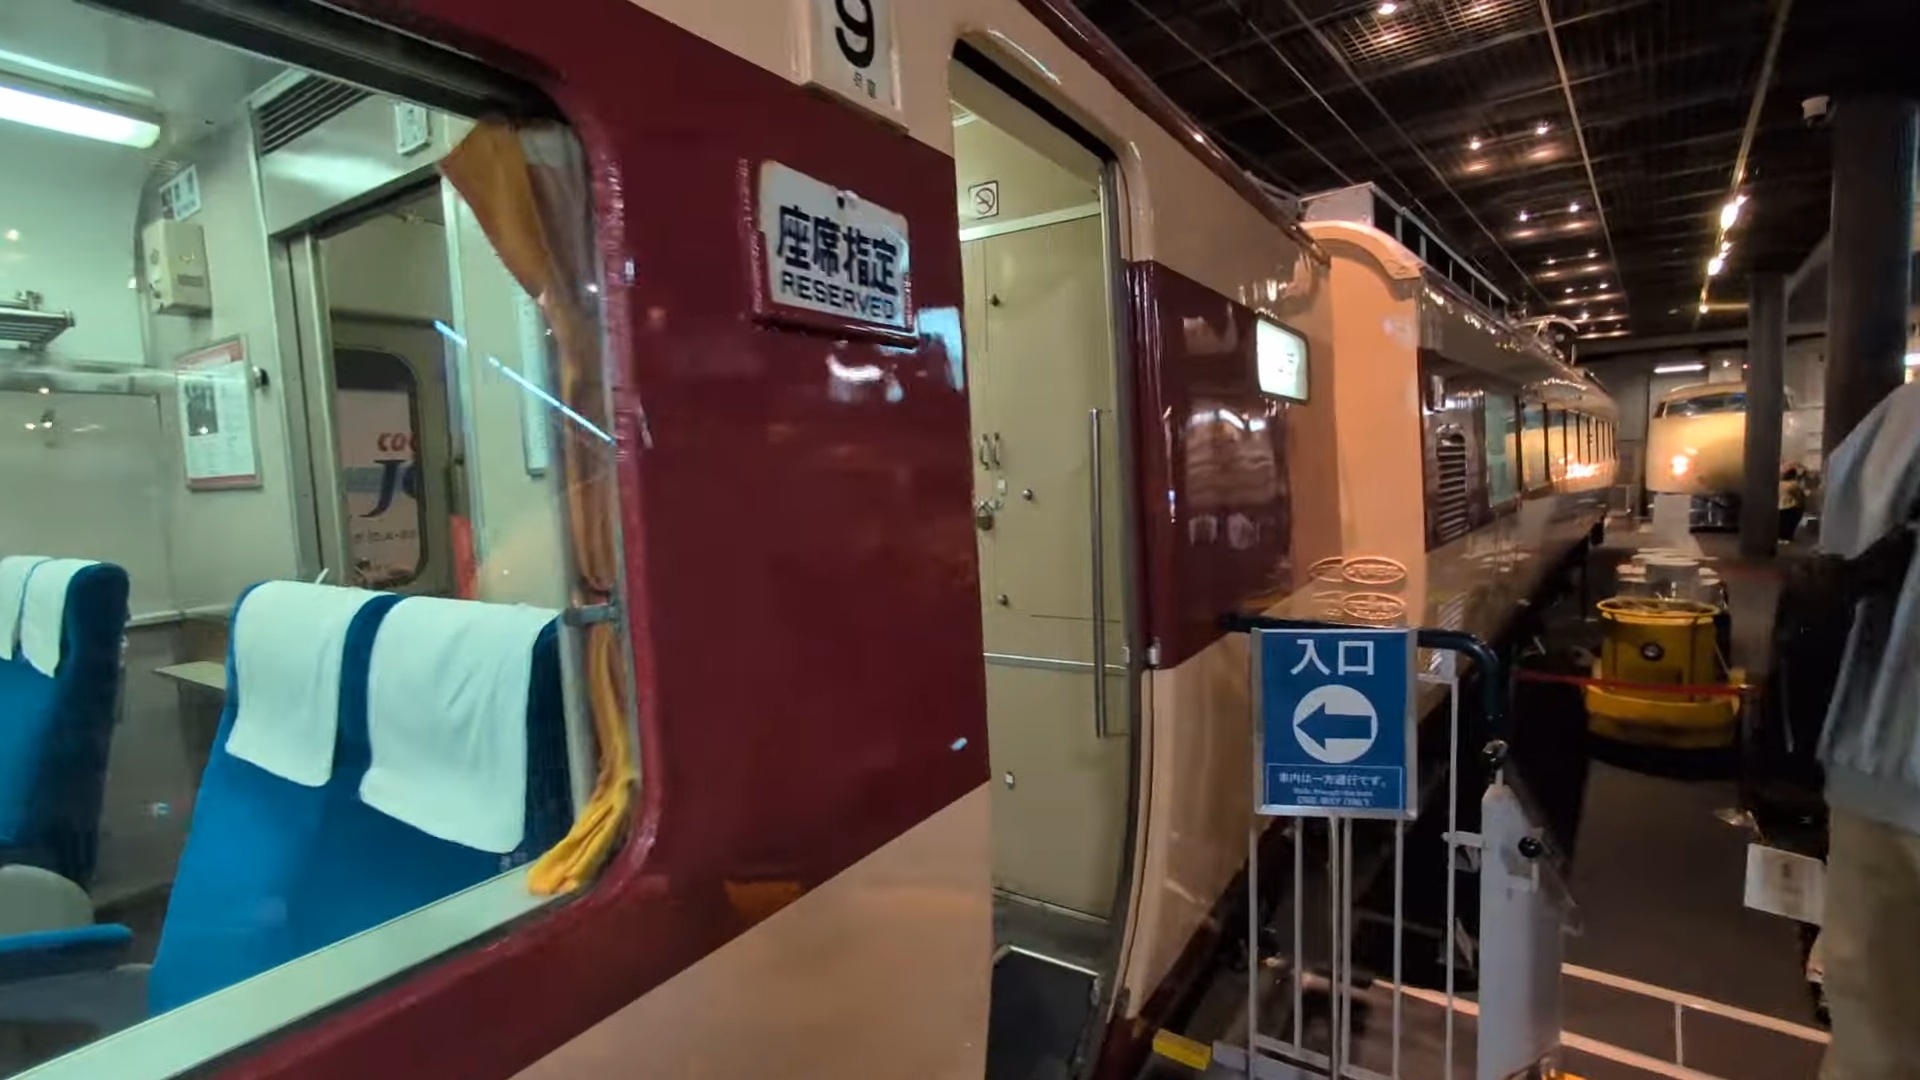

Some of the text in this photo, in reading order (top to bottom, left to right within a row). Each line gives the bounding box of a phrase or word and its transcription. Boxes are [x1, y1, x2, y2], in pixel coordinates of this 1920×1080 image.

[834, 0, 875, 69] 9
[777, 205, 897, 295] 座席指定
[781, 271, 896, 320] RESERVED
[1290, 638, 1375, 676] 入口
